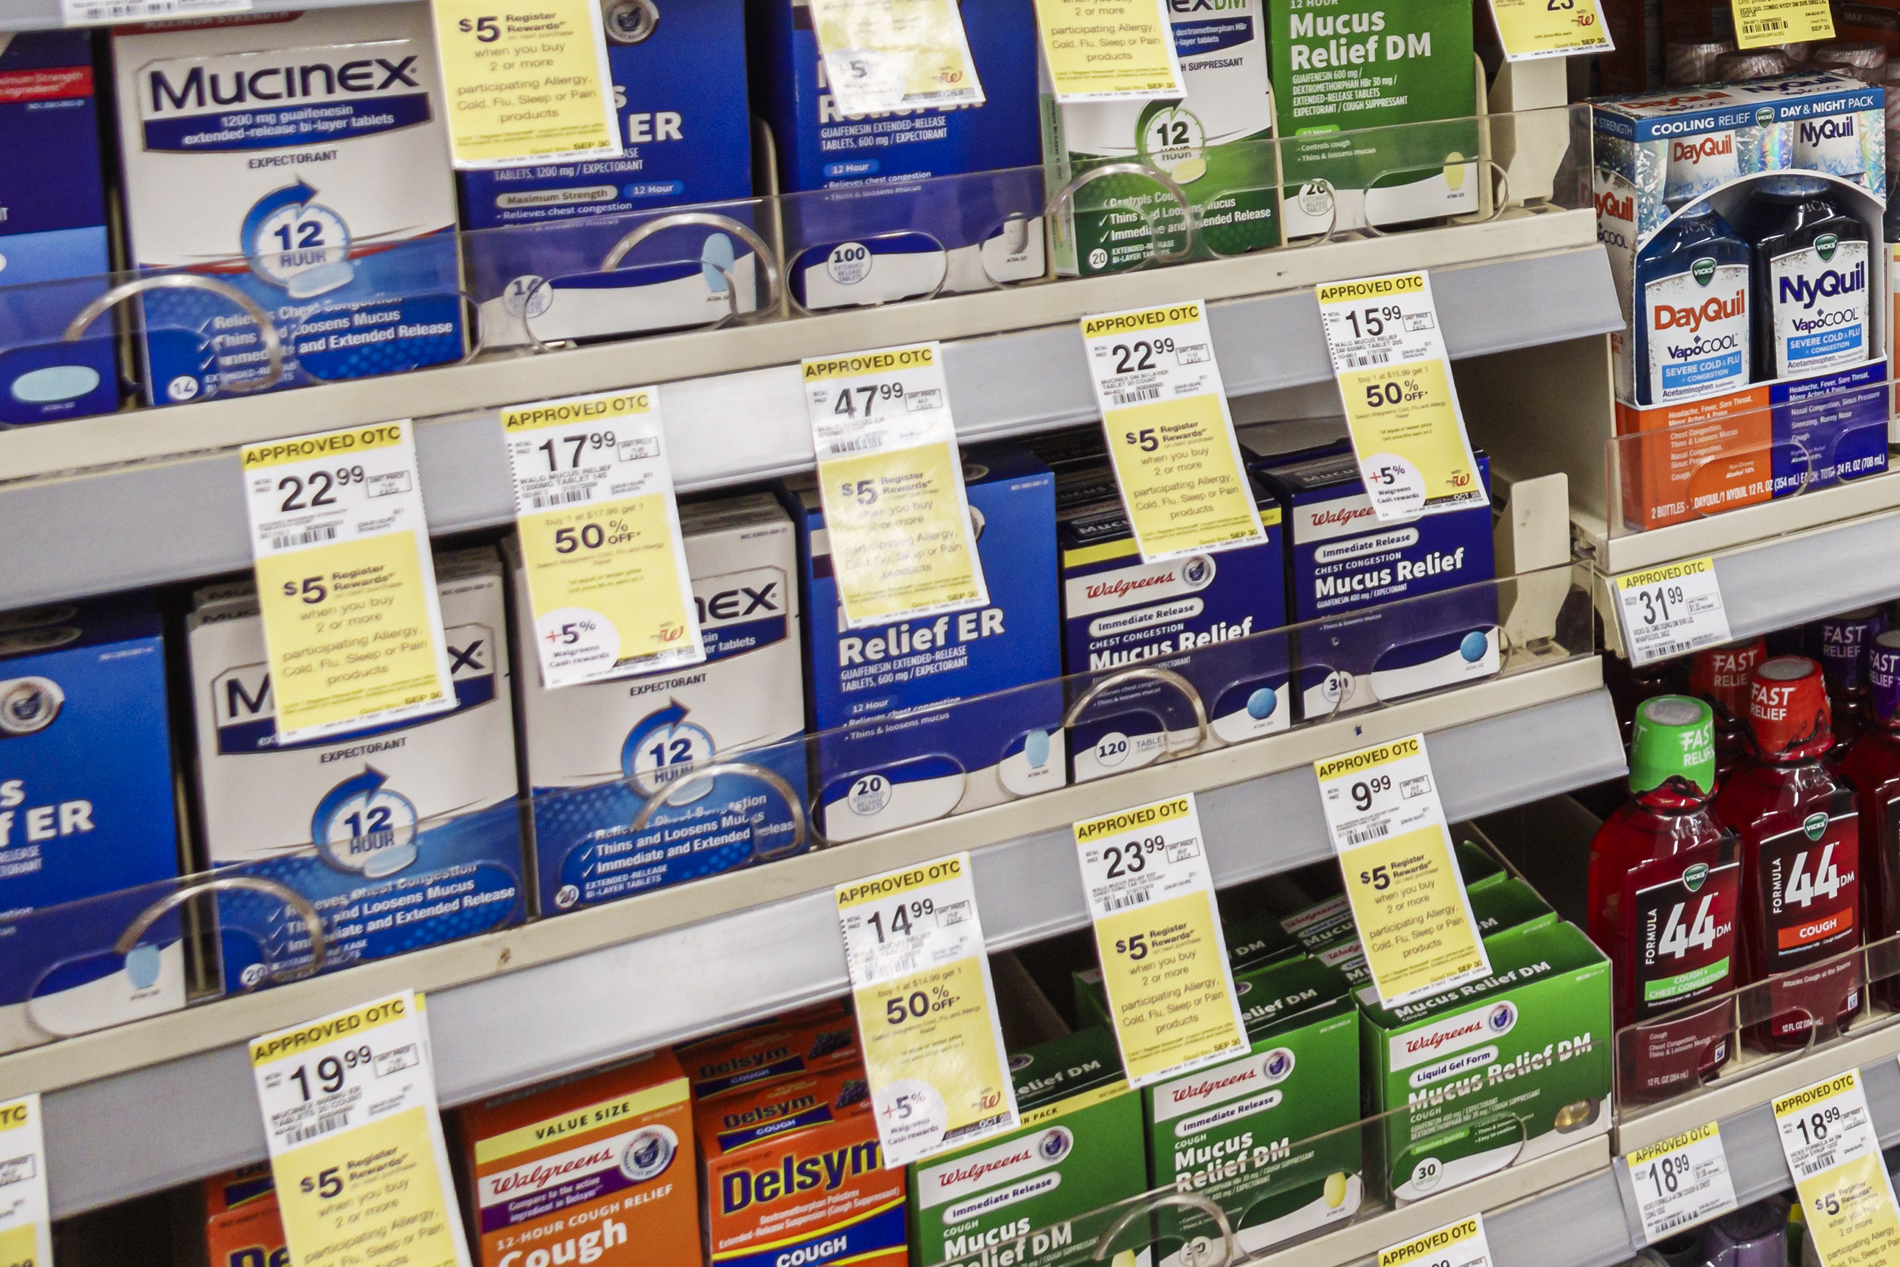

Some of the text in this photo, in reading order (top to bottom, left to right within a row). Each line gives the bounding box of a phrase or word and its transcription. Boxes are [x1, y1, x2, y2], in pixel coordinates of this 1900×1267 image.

[506, 12, 556, 25] Register
[1651, 112, 1750, 135] COOLING RELIEF
[248, 152, 338, 169] EXPECTORANT
[1780, 263, 1865, 309] NyQuil
[1654, 290, 1745, 332] DayQuil
[1323, 532, 1411, 560] Immediate Release
[1316, 548, 1464, 598] Mucus Relief
[838, 607, 1005, 665] Relief ER
[1099, 740, 1127, 757] 120
[1681, 729, 1713, 751] FAST
[1645, 908, 1657, 964] FORMULA
[1800, 919, 1837, 937] COUGH
[1407, 1020, 1482, 1054] Walgreens
[1417, 1052, 1491, 1082] Liquid Gel Form
[536, 1102, 631, 1140] VALUE SIZE
[492, 1146, 614, 1196] Walgreens
